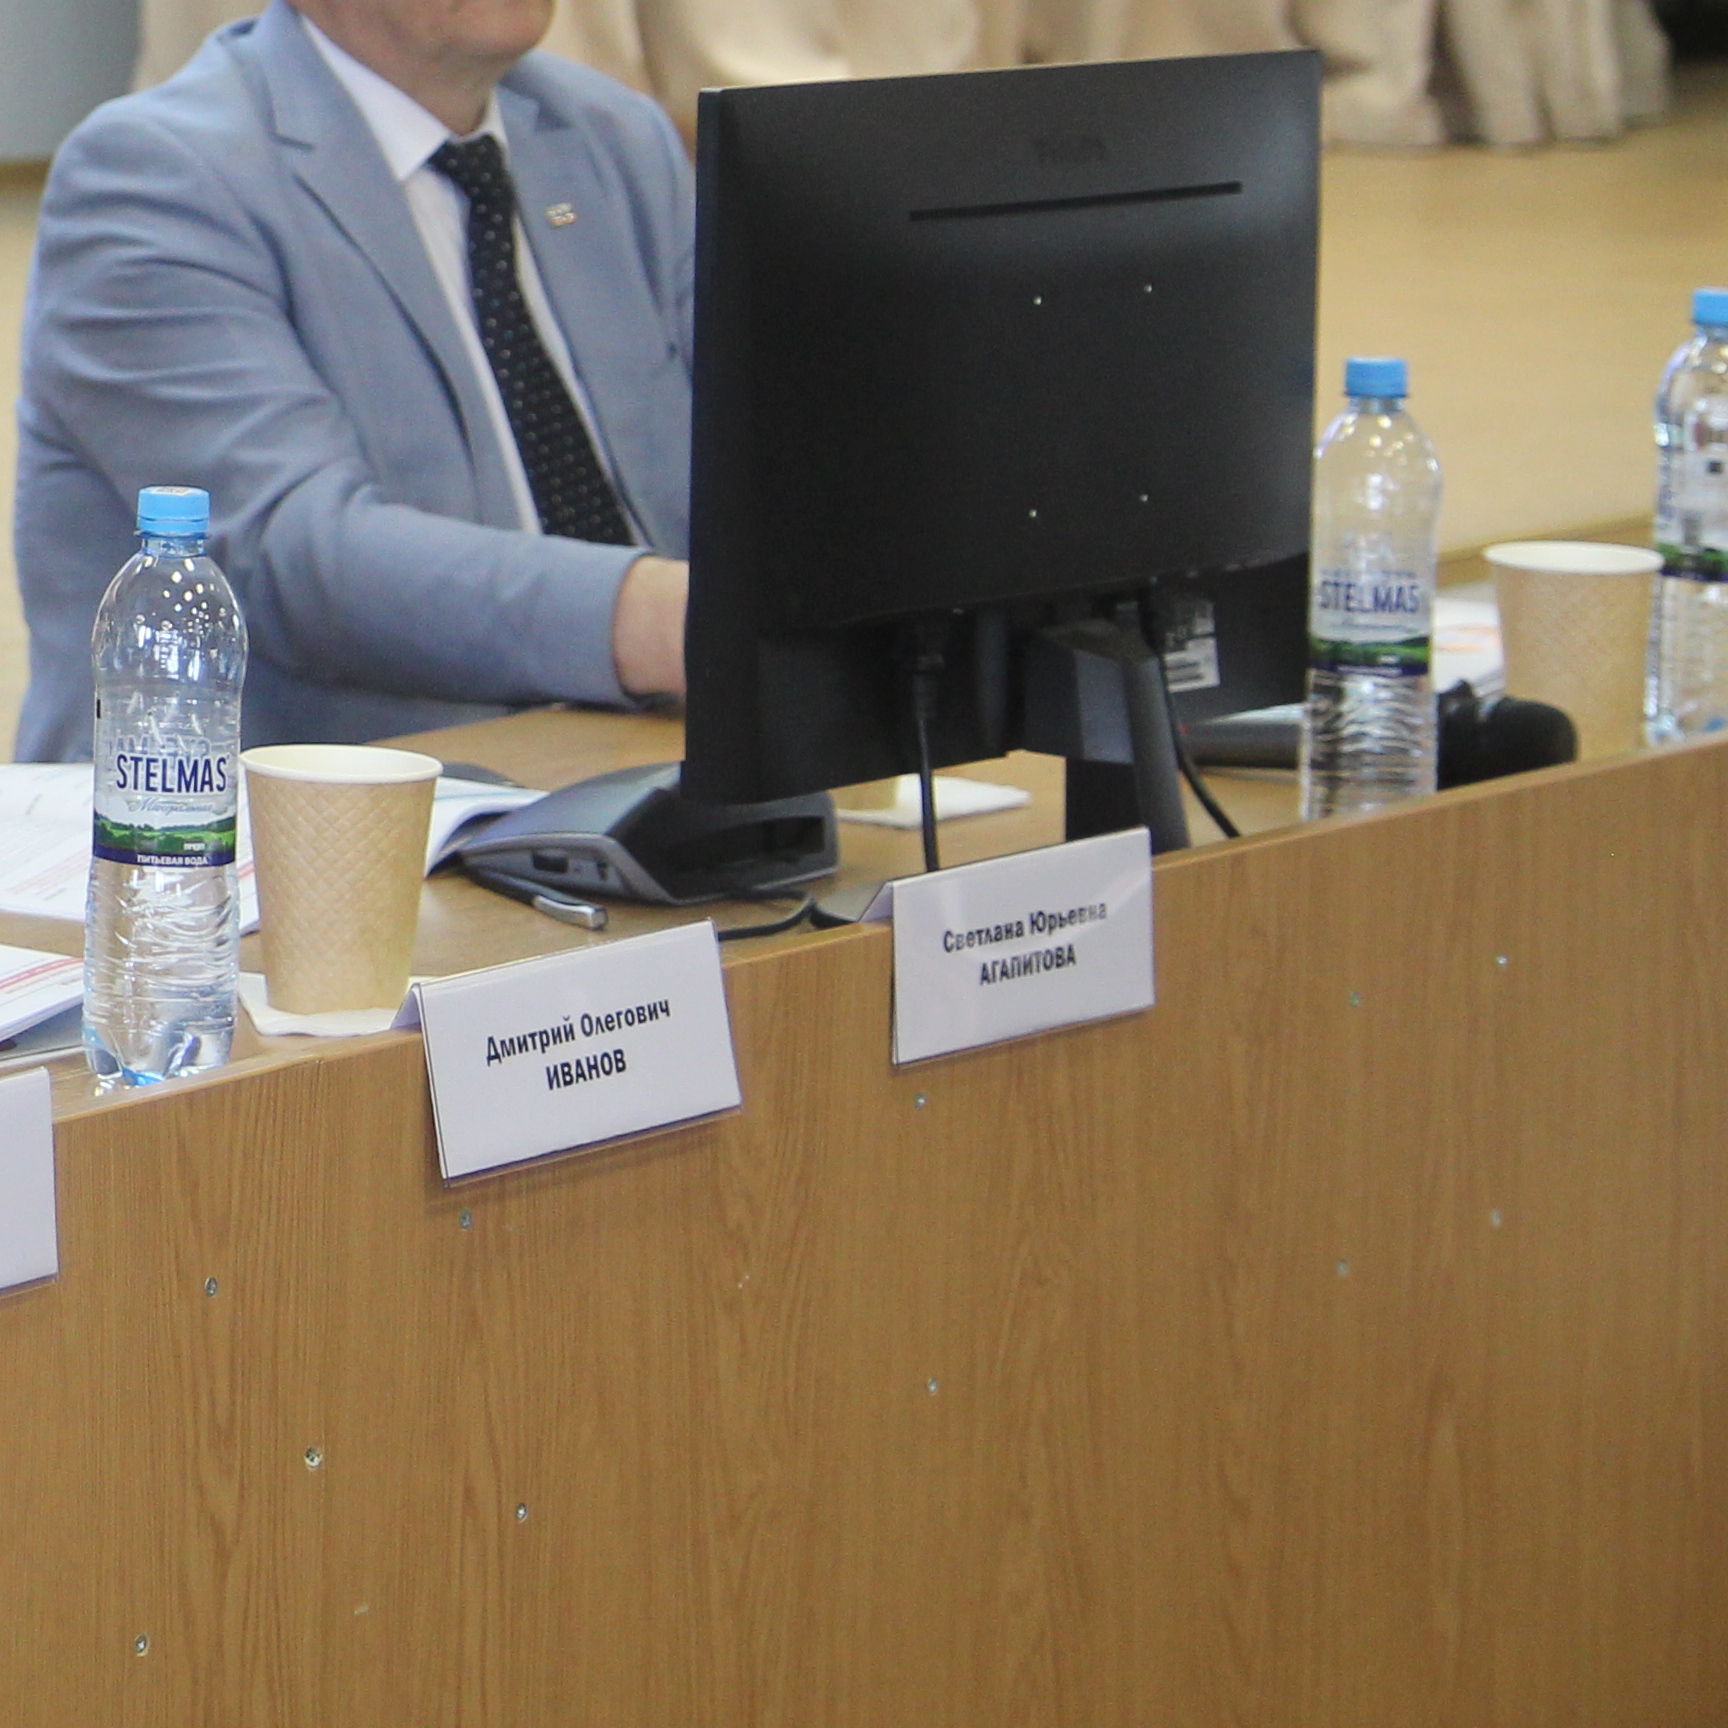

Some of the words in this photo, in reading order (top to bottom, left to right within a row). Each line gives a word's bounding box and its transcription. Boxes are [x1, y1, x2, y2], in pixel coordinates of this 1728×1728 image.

[115, 753, 228, 794] STELMAS
[942, 920, 1025, 954] Светлана
[1028, 902, 1108, 936] Юрьевна
[979, 942, 1078, 986] АГАПИТОВА
[485, 1014, 576, 1067] Дмитрий
[580, 999, 672, 1038] Олегович
[545, 1048, 628, 1091] ИВАНОВ
